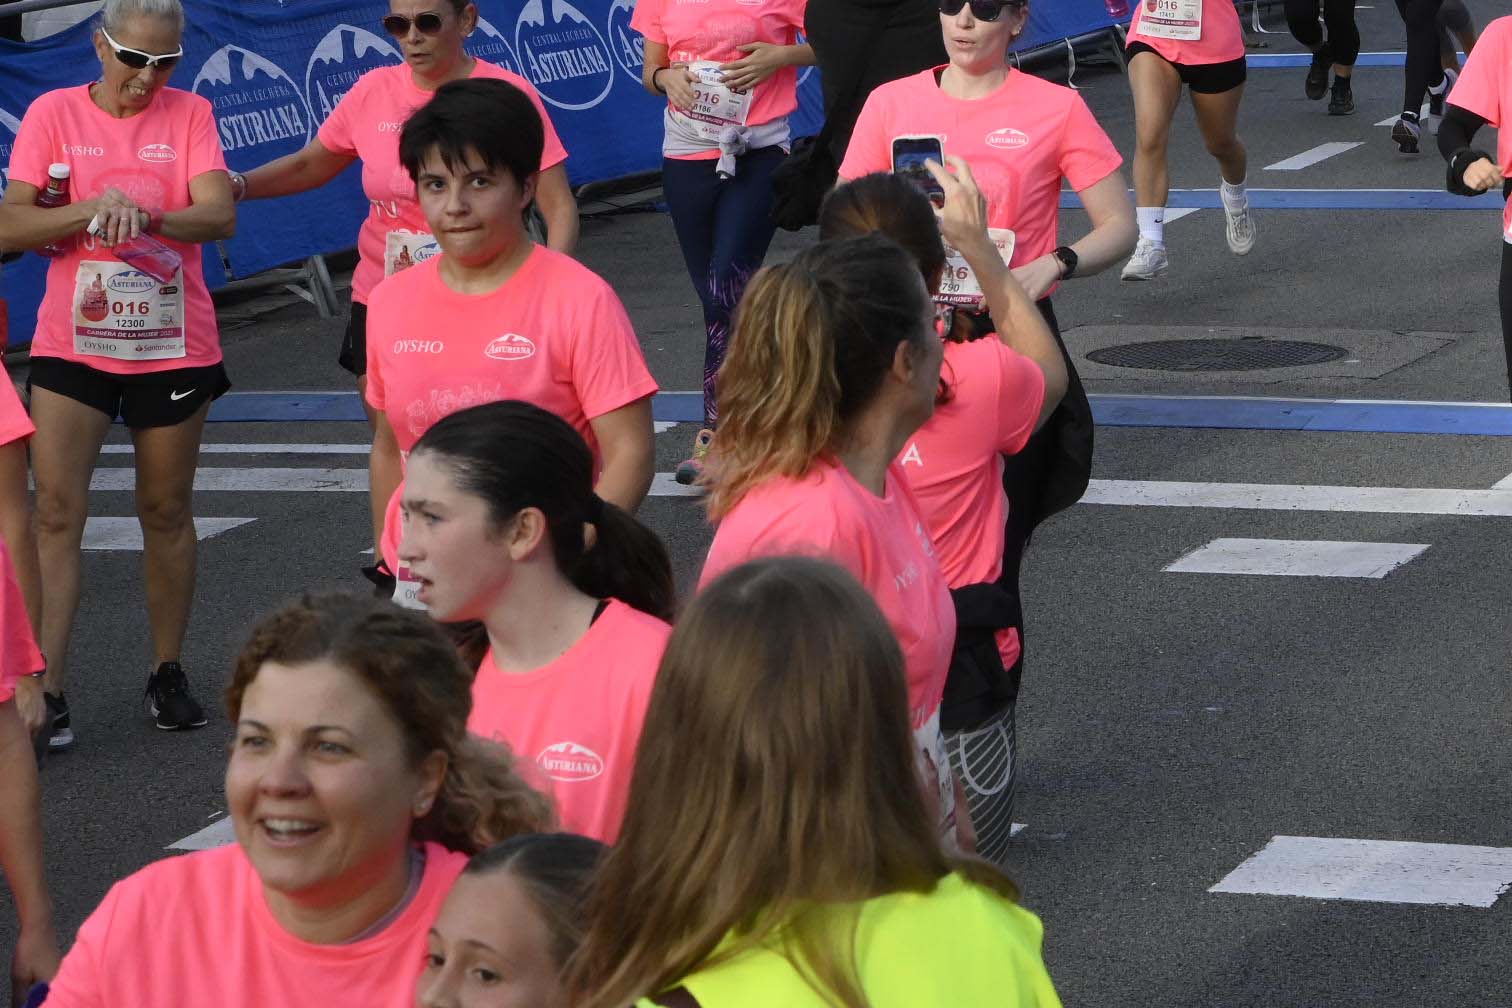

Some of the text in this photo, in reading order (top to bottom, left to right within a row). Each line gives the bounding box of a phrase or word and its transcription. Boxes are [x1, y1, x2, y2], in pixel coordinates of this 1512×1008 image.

[1158, 0, 1178, 10] 016
[533, 28, 592, 47] CENTRAL LECHERA
[525, 43, 609, 86] ASTURIANA
[212, 84, 291, 108] CENTRAL LECHERA
[62, 143, 104, 157] OYSHO
[111, 279, 153, 289] ASTURIANA
[950, 295, 973, 304] MUJER
[112, 301, 150, 315] 016
[116, 319, 145, 328] 12300
[86, 329, 117, 337] CARRERA
[84, 341, 117, 352] OYSHO
[143, 343, 177, 352] Santander
[393, 339, 444, 355] OYSHO
